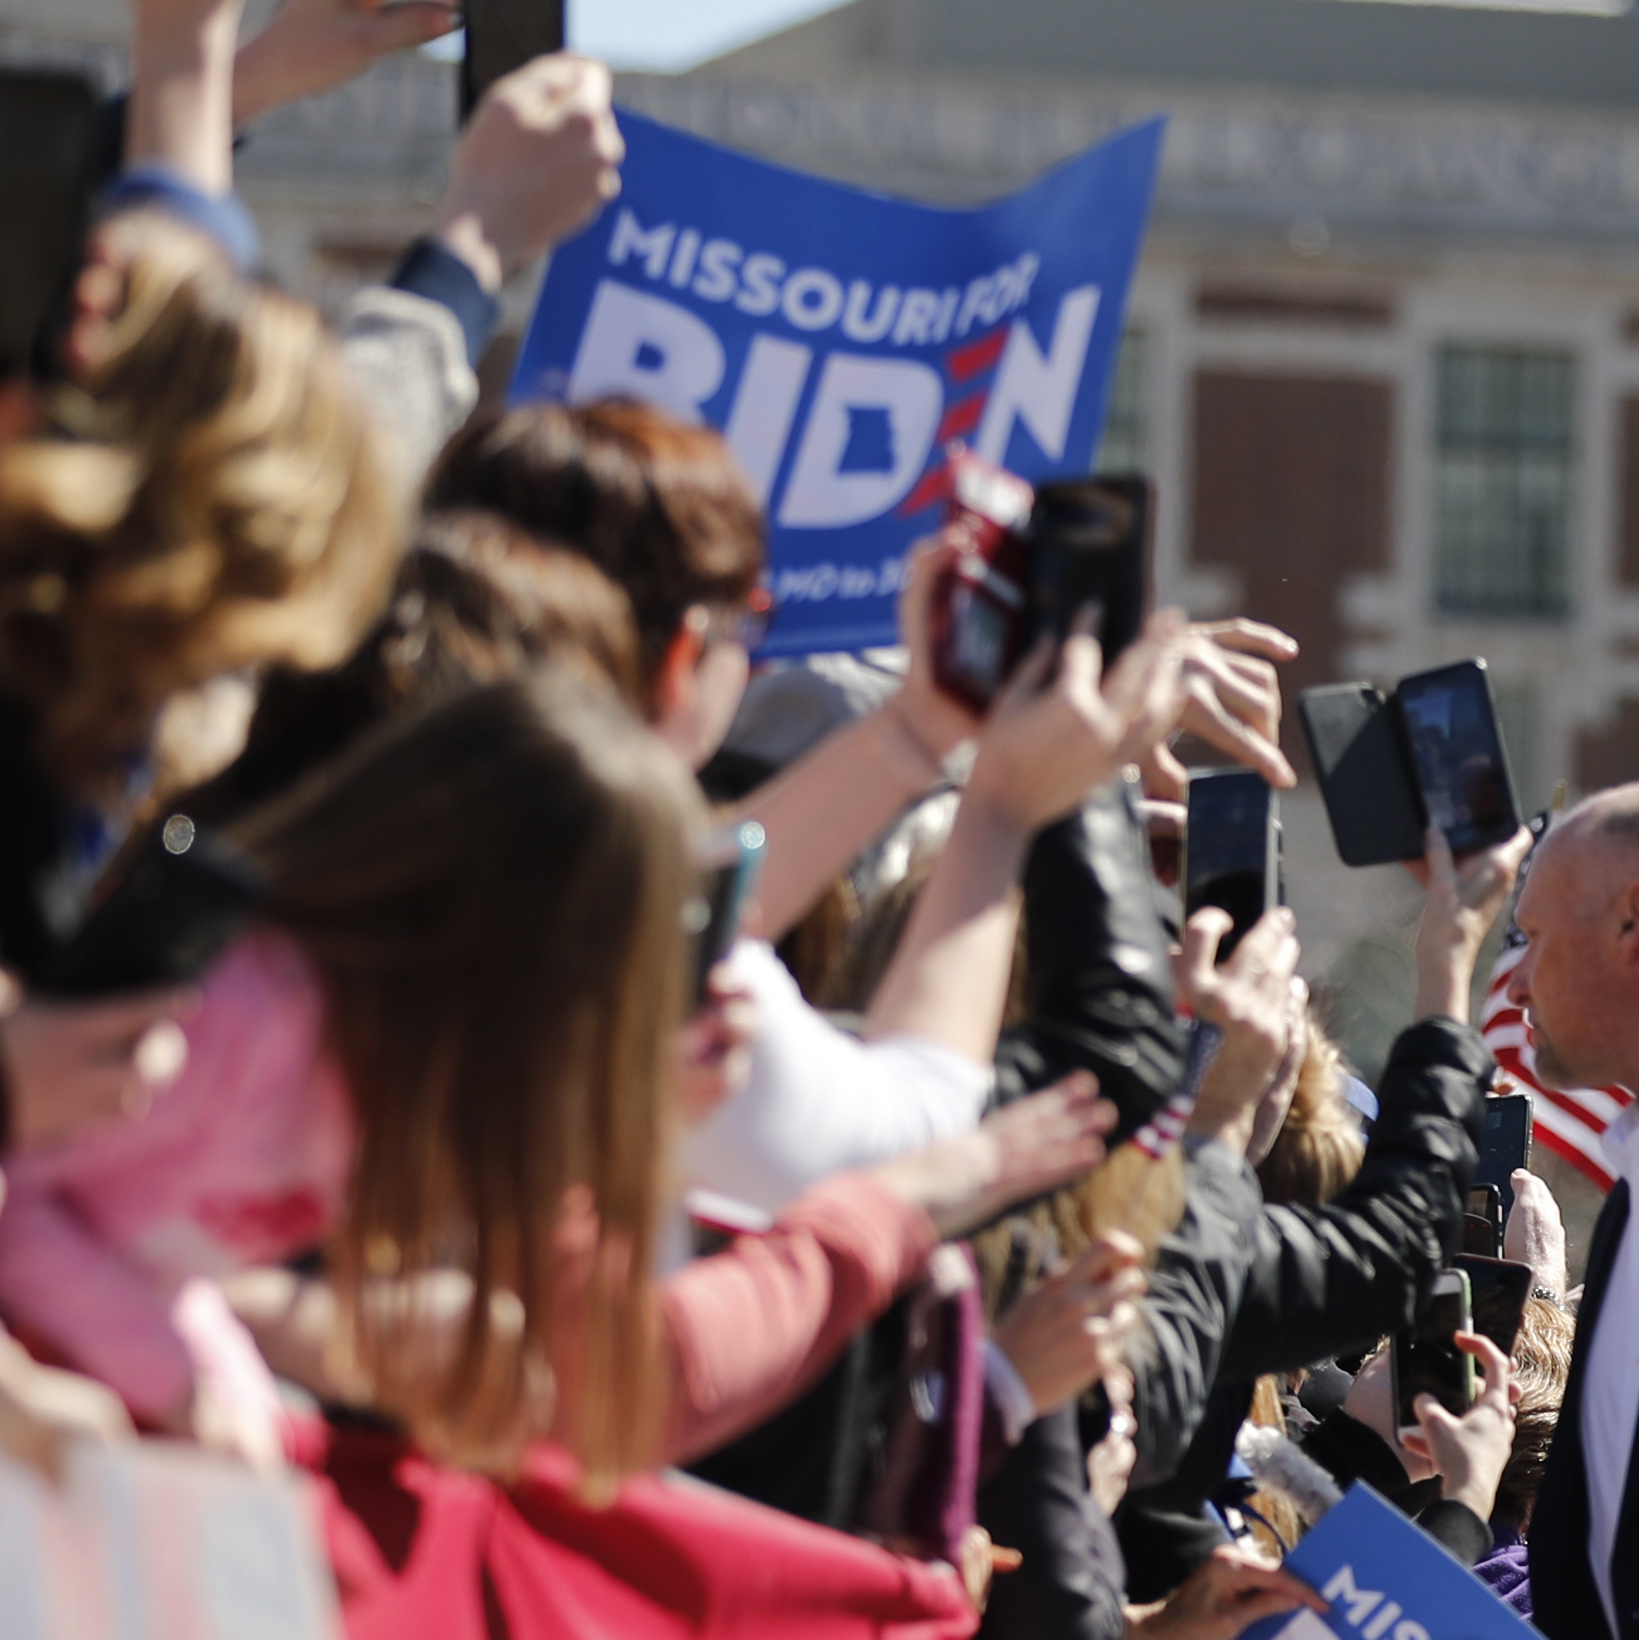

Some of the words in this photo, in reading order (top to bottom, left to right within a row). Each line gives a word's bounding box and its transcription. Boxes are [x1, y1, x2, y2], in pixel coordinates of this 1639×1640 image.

[606, 208, 957, 346] MISSOURI
[953, 250, 1041, 338] FOR
[567, 277, 1101, 530] BIDEN
